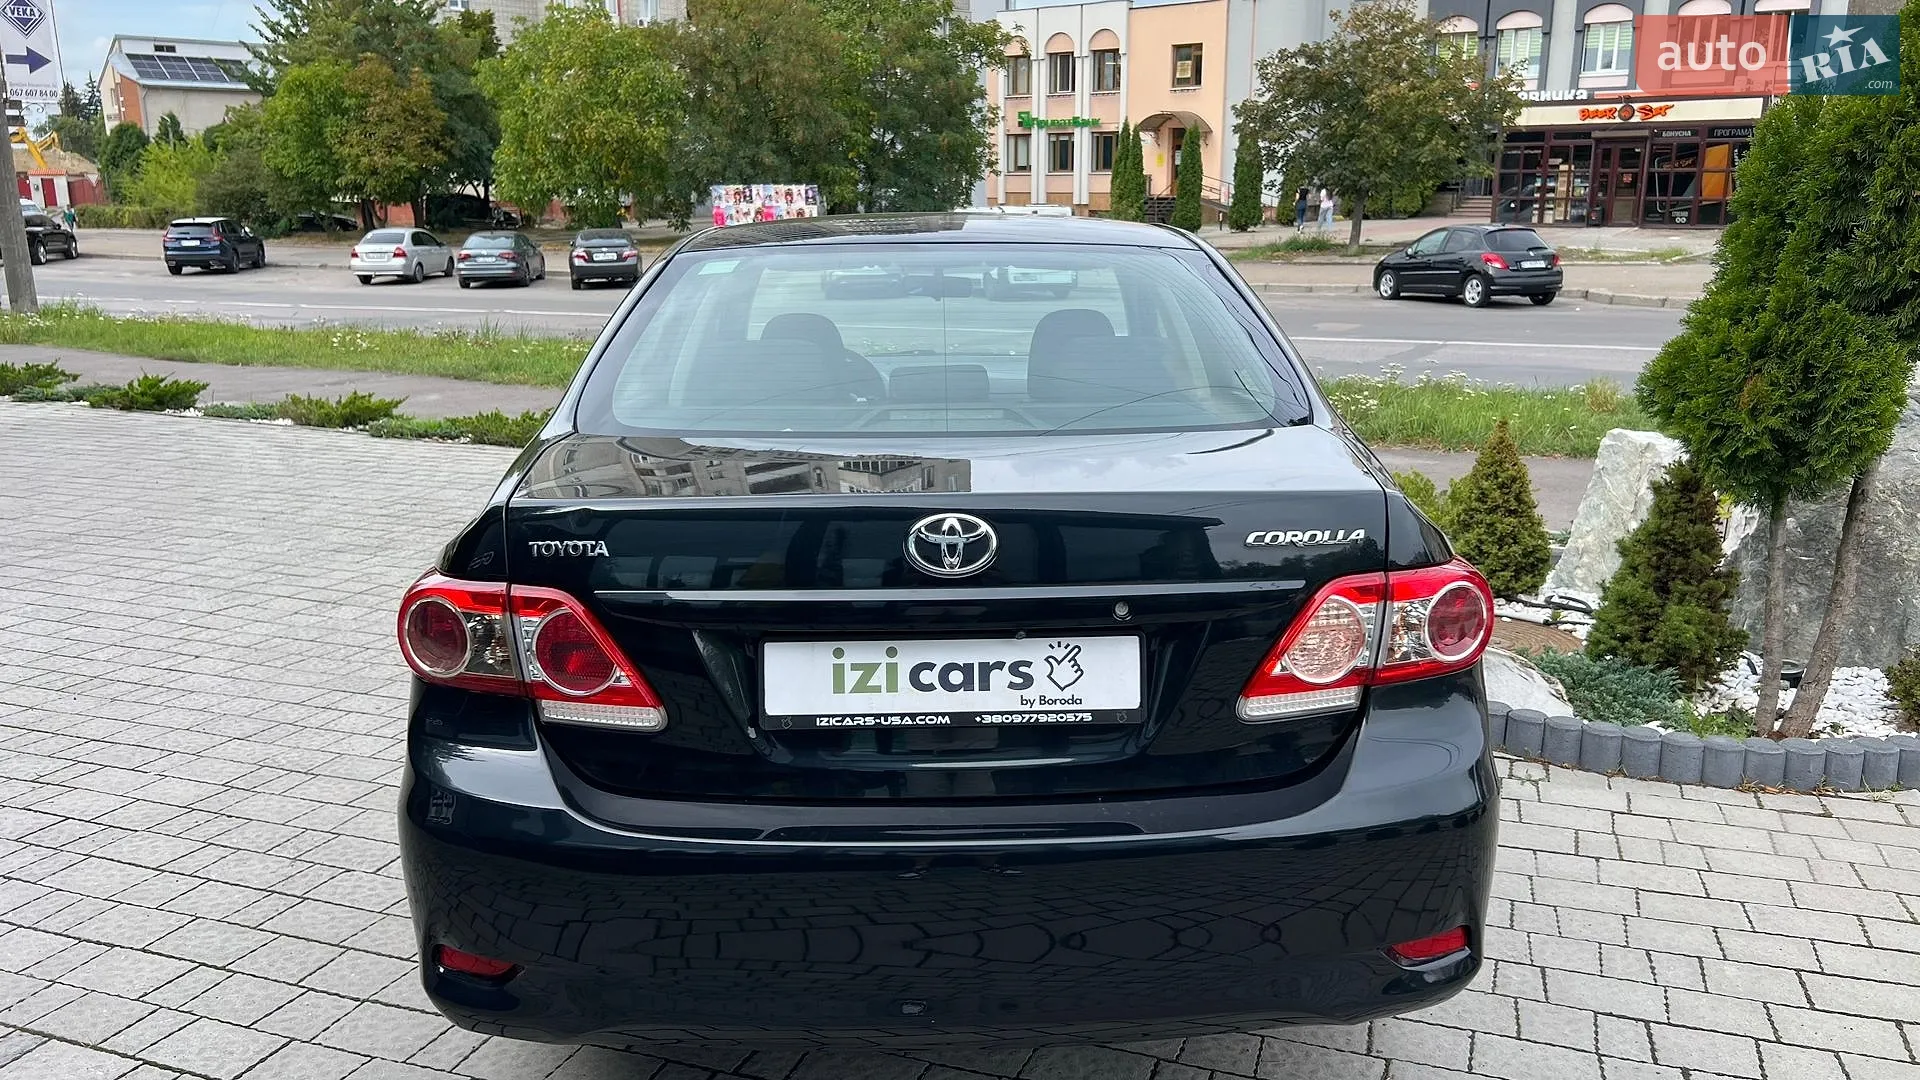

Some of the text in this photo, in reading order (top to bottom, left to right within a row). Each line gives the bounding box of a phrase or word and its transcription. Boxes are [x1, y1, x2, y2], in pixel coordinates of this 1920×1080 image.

[9, 6, 36, 17] VEKA
[10, 88, 58, 98] 067 607 84 00
[1245, 529, 1366, 546] COROLLA
[528, 540, 610, 557] TOYOTA
[832, 646, 1035, 694] izi cars
[1020, 694, 1083, 707] by Boroda
[816, 712, 1093, 726] IZICARS-USA.COM +380977920575
